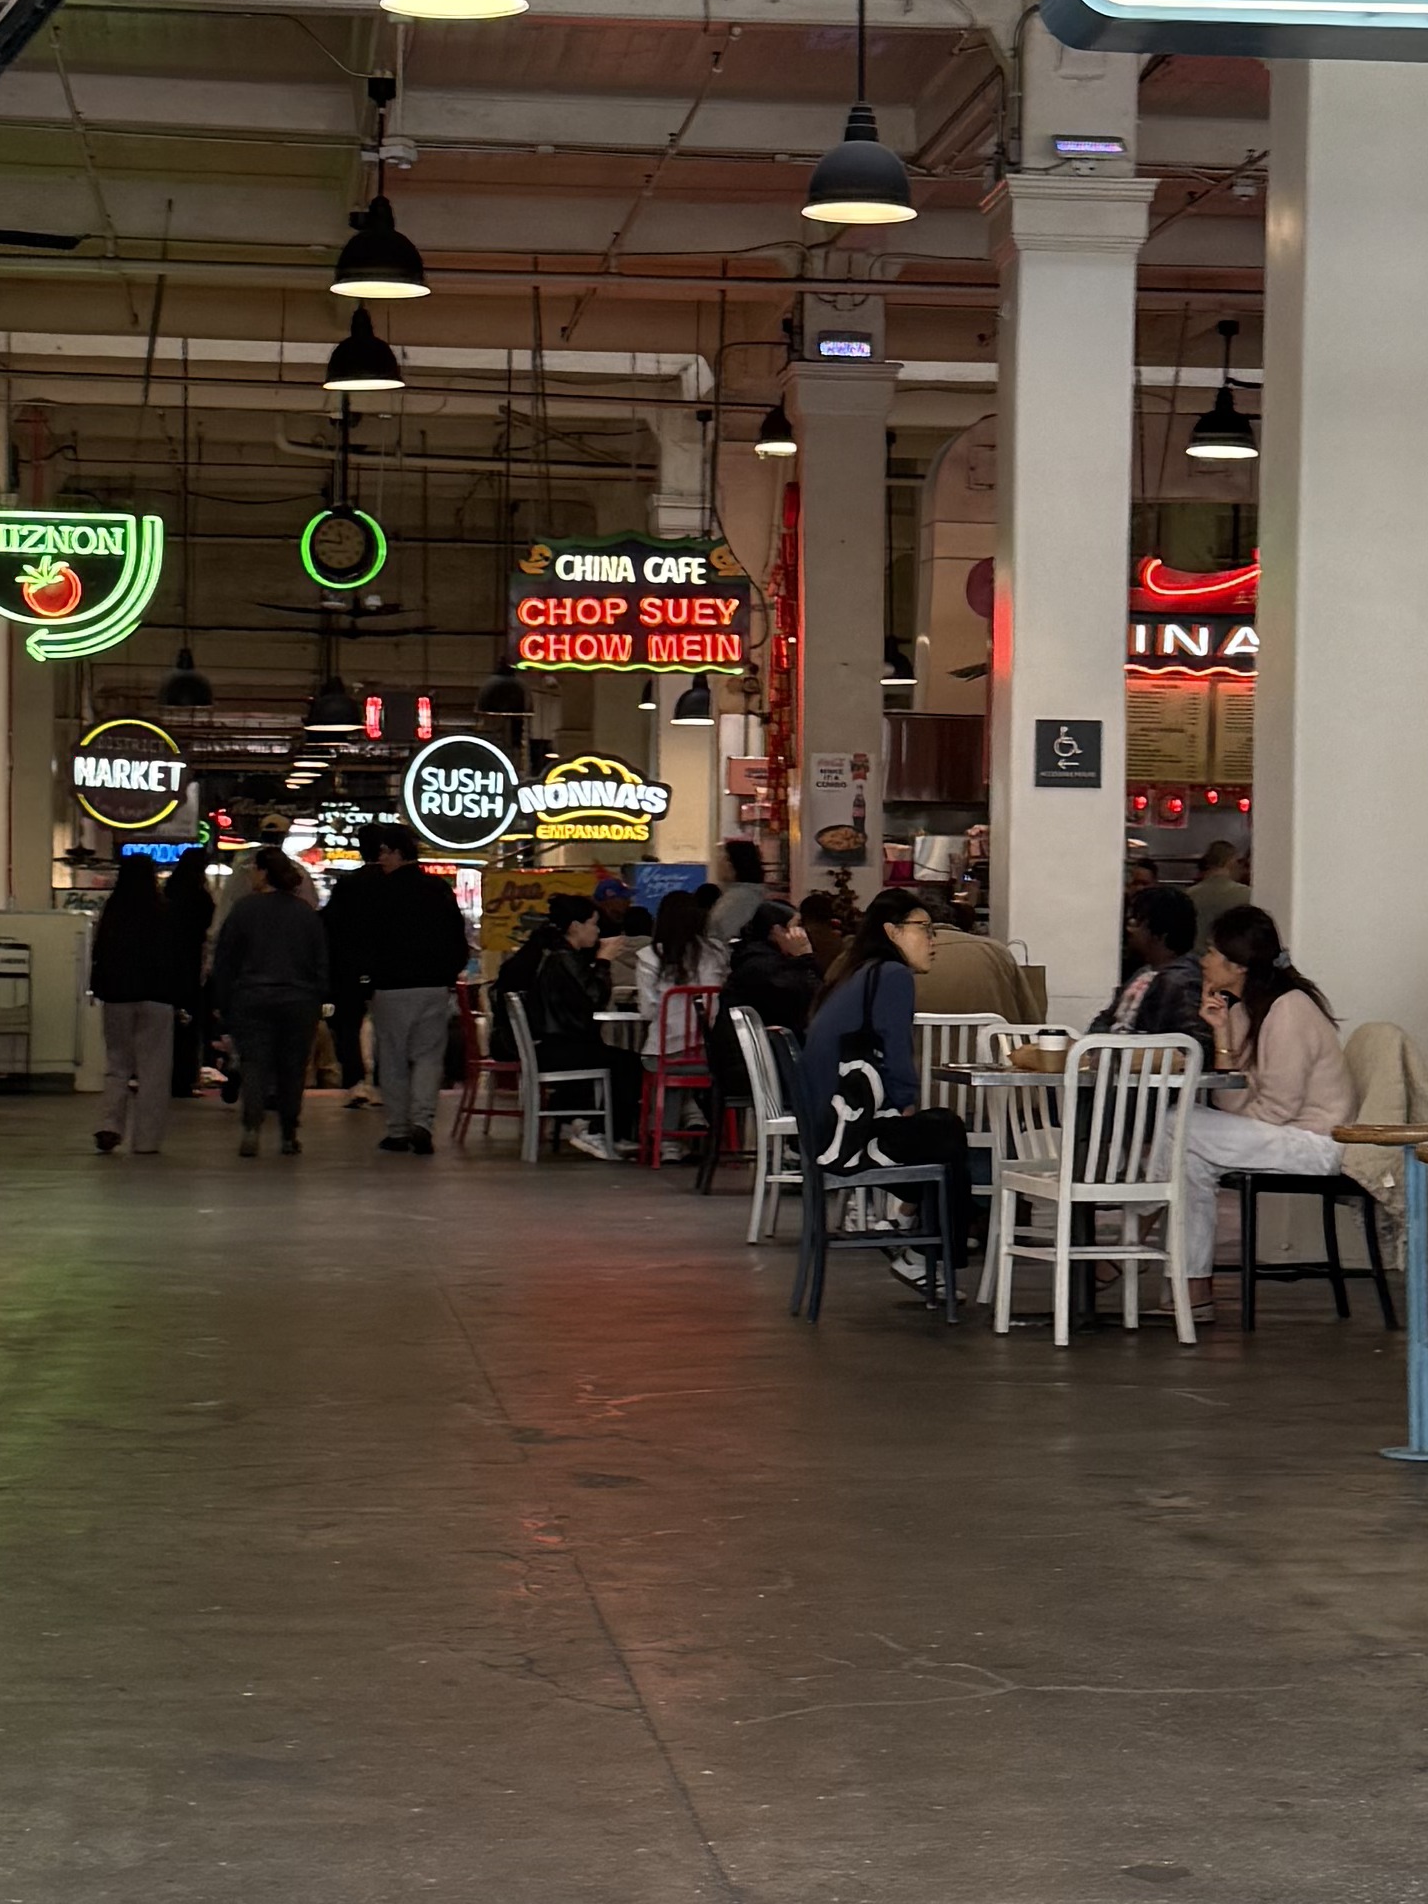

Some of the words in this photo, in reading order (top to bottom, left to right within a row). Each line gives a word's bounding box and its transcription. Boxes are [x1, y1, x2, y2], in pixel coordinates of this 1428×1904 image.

[554, 554, 637, 583] CHINA
[643, 556, 708, 585] CAFE
[517, 597, 629, 626] CHOP
[639, 598, 740, 626] SUEY
[519, 634, 633, 663] CHOW
[647, 634, 742, 663] MEIN
[1128, 623, 1260, 656] INA
[73, 756, 187, 792] MARKET
[421, 766, 504, 794] SUSHI
[421, 793, 504, 819] RUSH
[517, 780, 670, 815] NONNA'S
[536, 823, 650, 841] EMPANADAS
